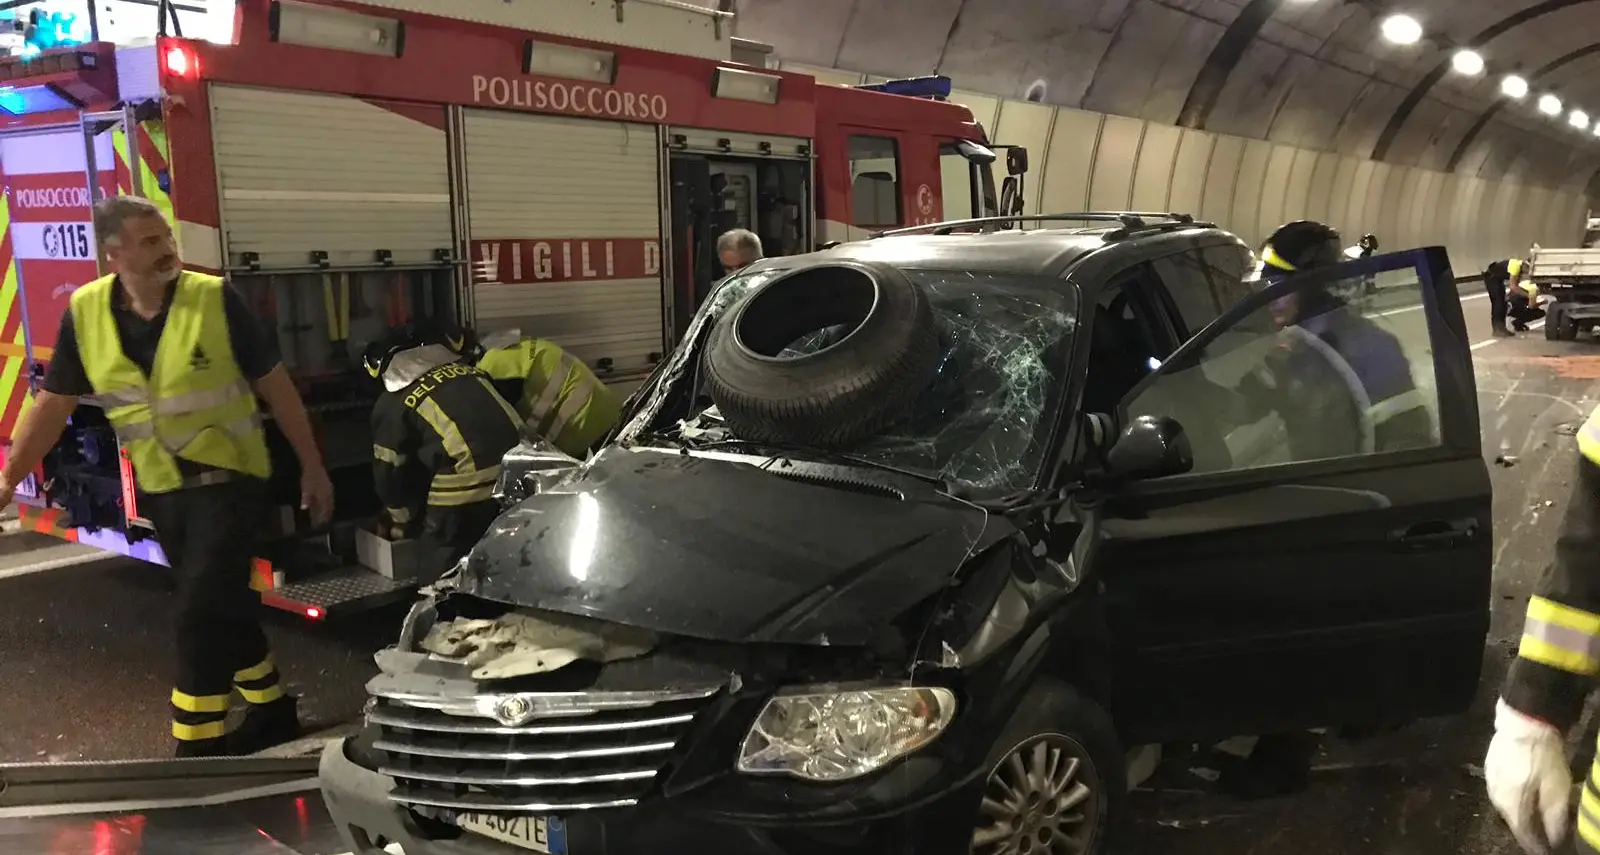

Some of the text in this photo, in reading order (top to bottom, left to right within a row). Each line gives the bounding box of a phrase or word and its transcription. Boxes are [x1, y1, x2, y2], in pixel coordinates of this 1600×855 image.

[472, 74, 667, 120] POLISOCCORSO
[16, 186, 106, 208] POLISOCCOR
[58, 224, 88, 257] 115
[480, 241, 614, 281] VIGILI
[404, 382, 435, 408] DEL
